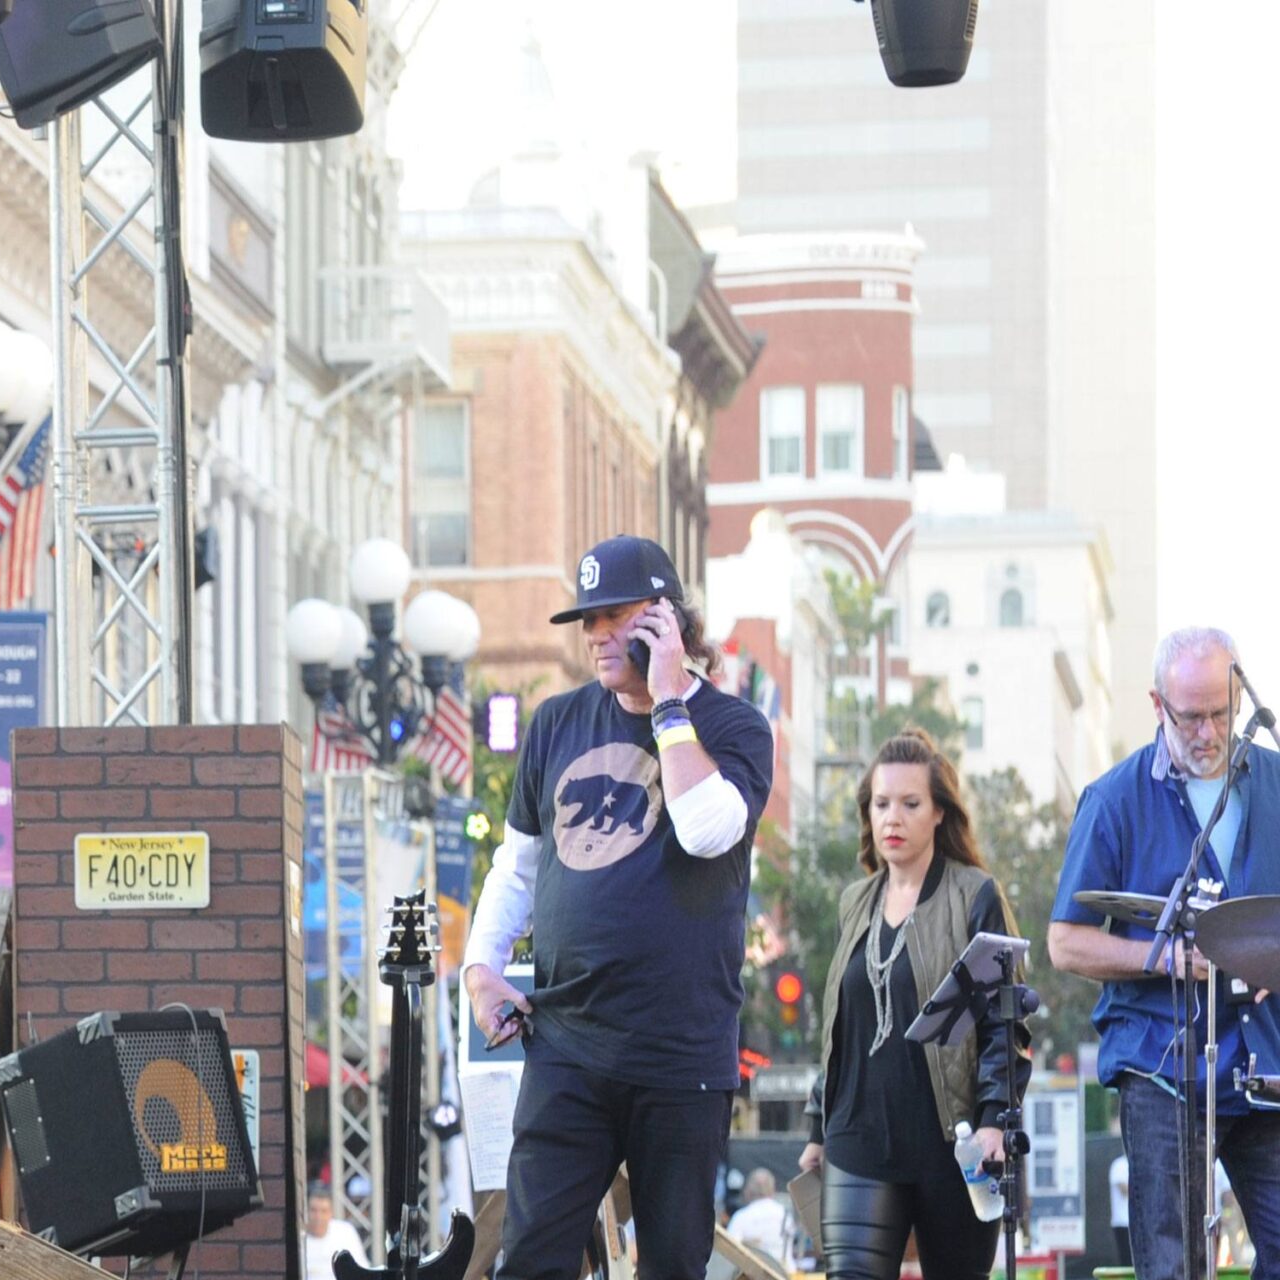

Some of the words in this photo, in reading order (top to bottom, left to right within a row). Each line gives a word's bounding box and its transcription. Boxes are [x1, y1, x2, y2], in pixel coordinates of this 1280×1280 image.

[108, 838, 137, 850] New
[138, 838, 175, 852] Jersey
[108, 891, 145, 902] Garden
[148, 891, 175, 902] State
[161, 1144, 227, 1159] Mark
[161, 1157, 227, 1173] bass
